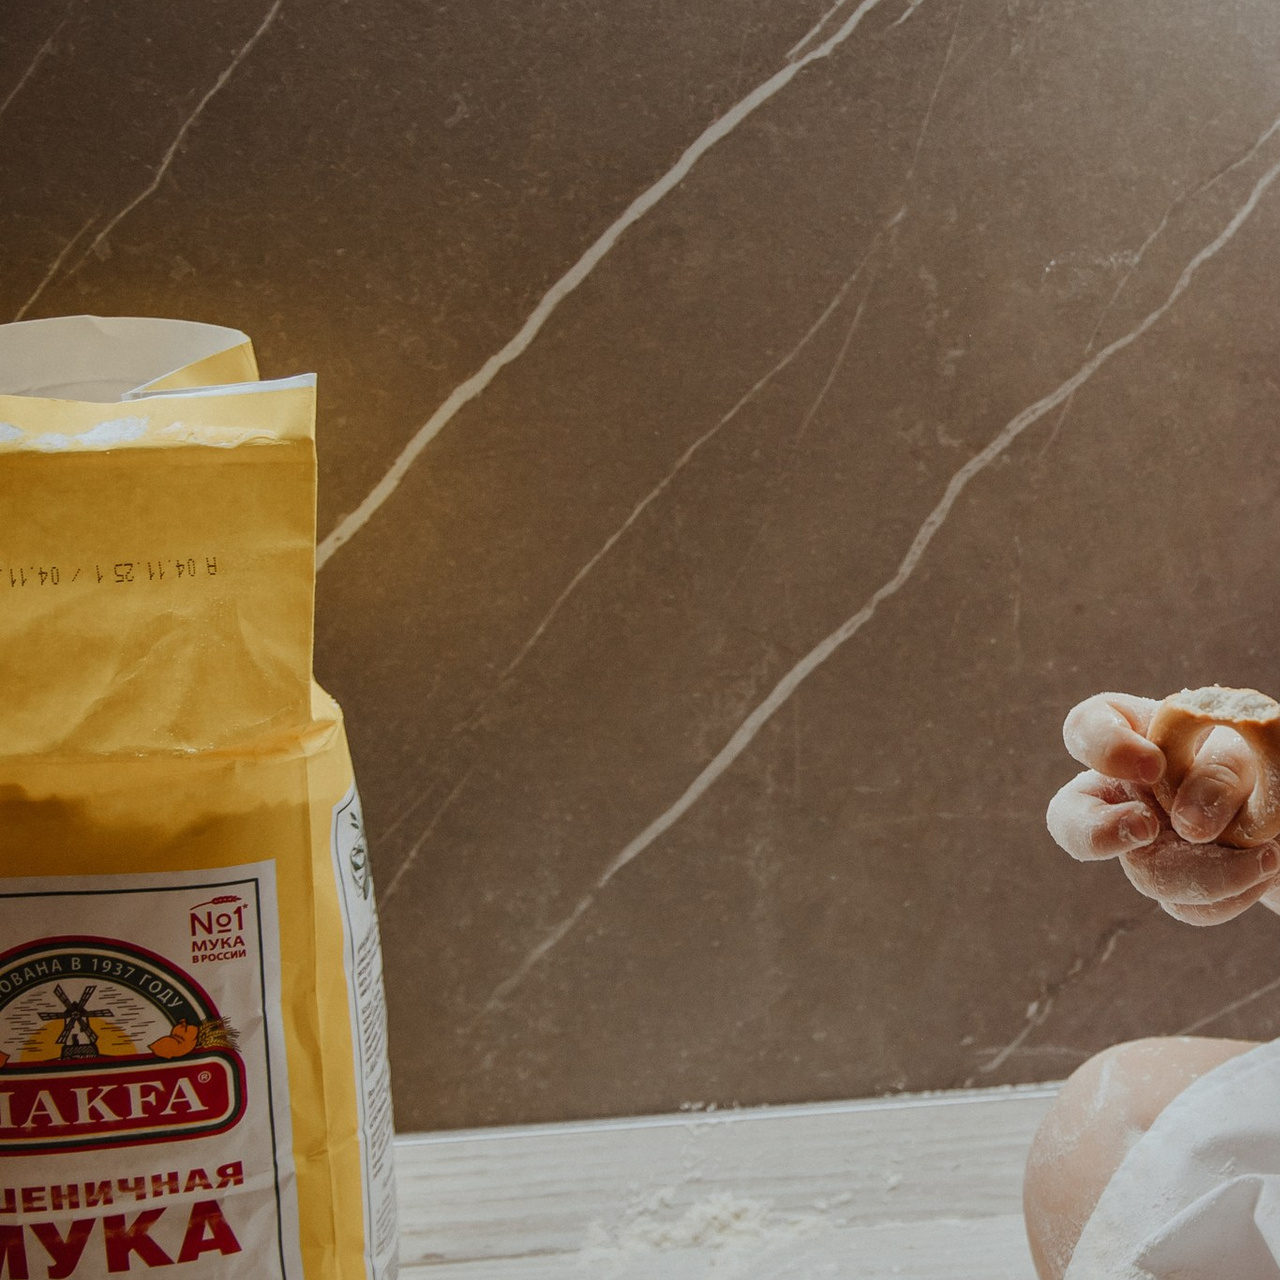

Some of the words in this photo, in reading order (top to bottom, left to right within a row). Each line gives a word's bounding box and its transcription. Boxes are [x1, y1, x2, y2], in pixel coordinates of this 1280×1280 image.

[114, 558, 197, 583] 04.11.25
[191, 935, 246, 953] МУКА
[192, 955, 200, 964] В
[201, 949, 247, 963] РОССИИ
[0, 959, 62, 998] ОВАНА
[71, 957, 82, 971] В
[92, 958, 136, 979] 1937
[138, 974, 184, 1008] ГОДУ
